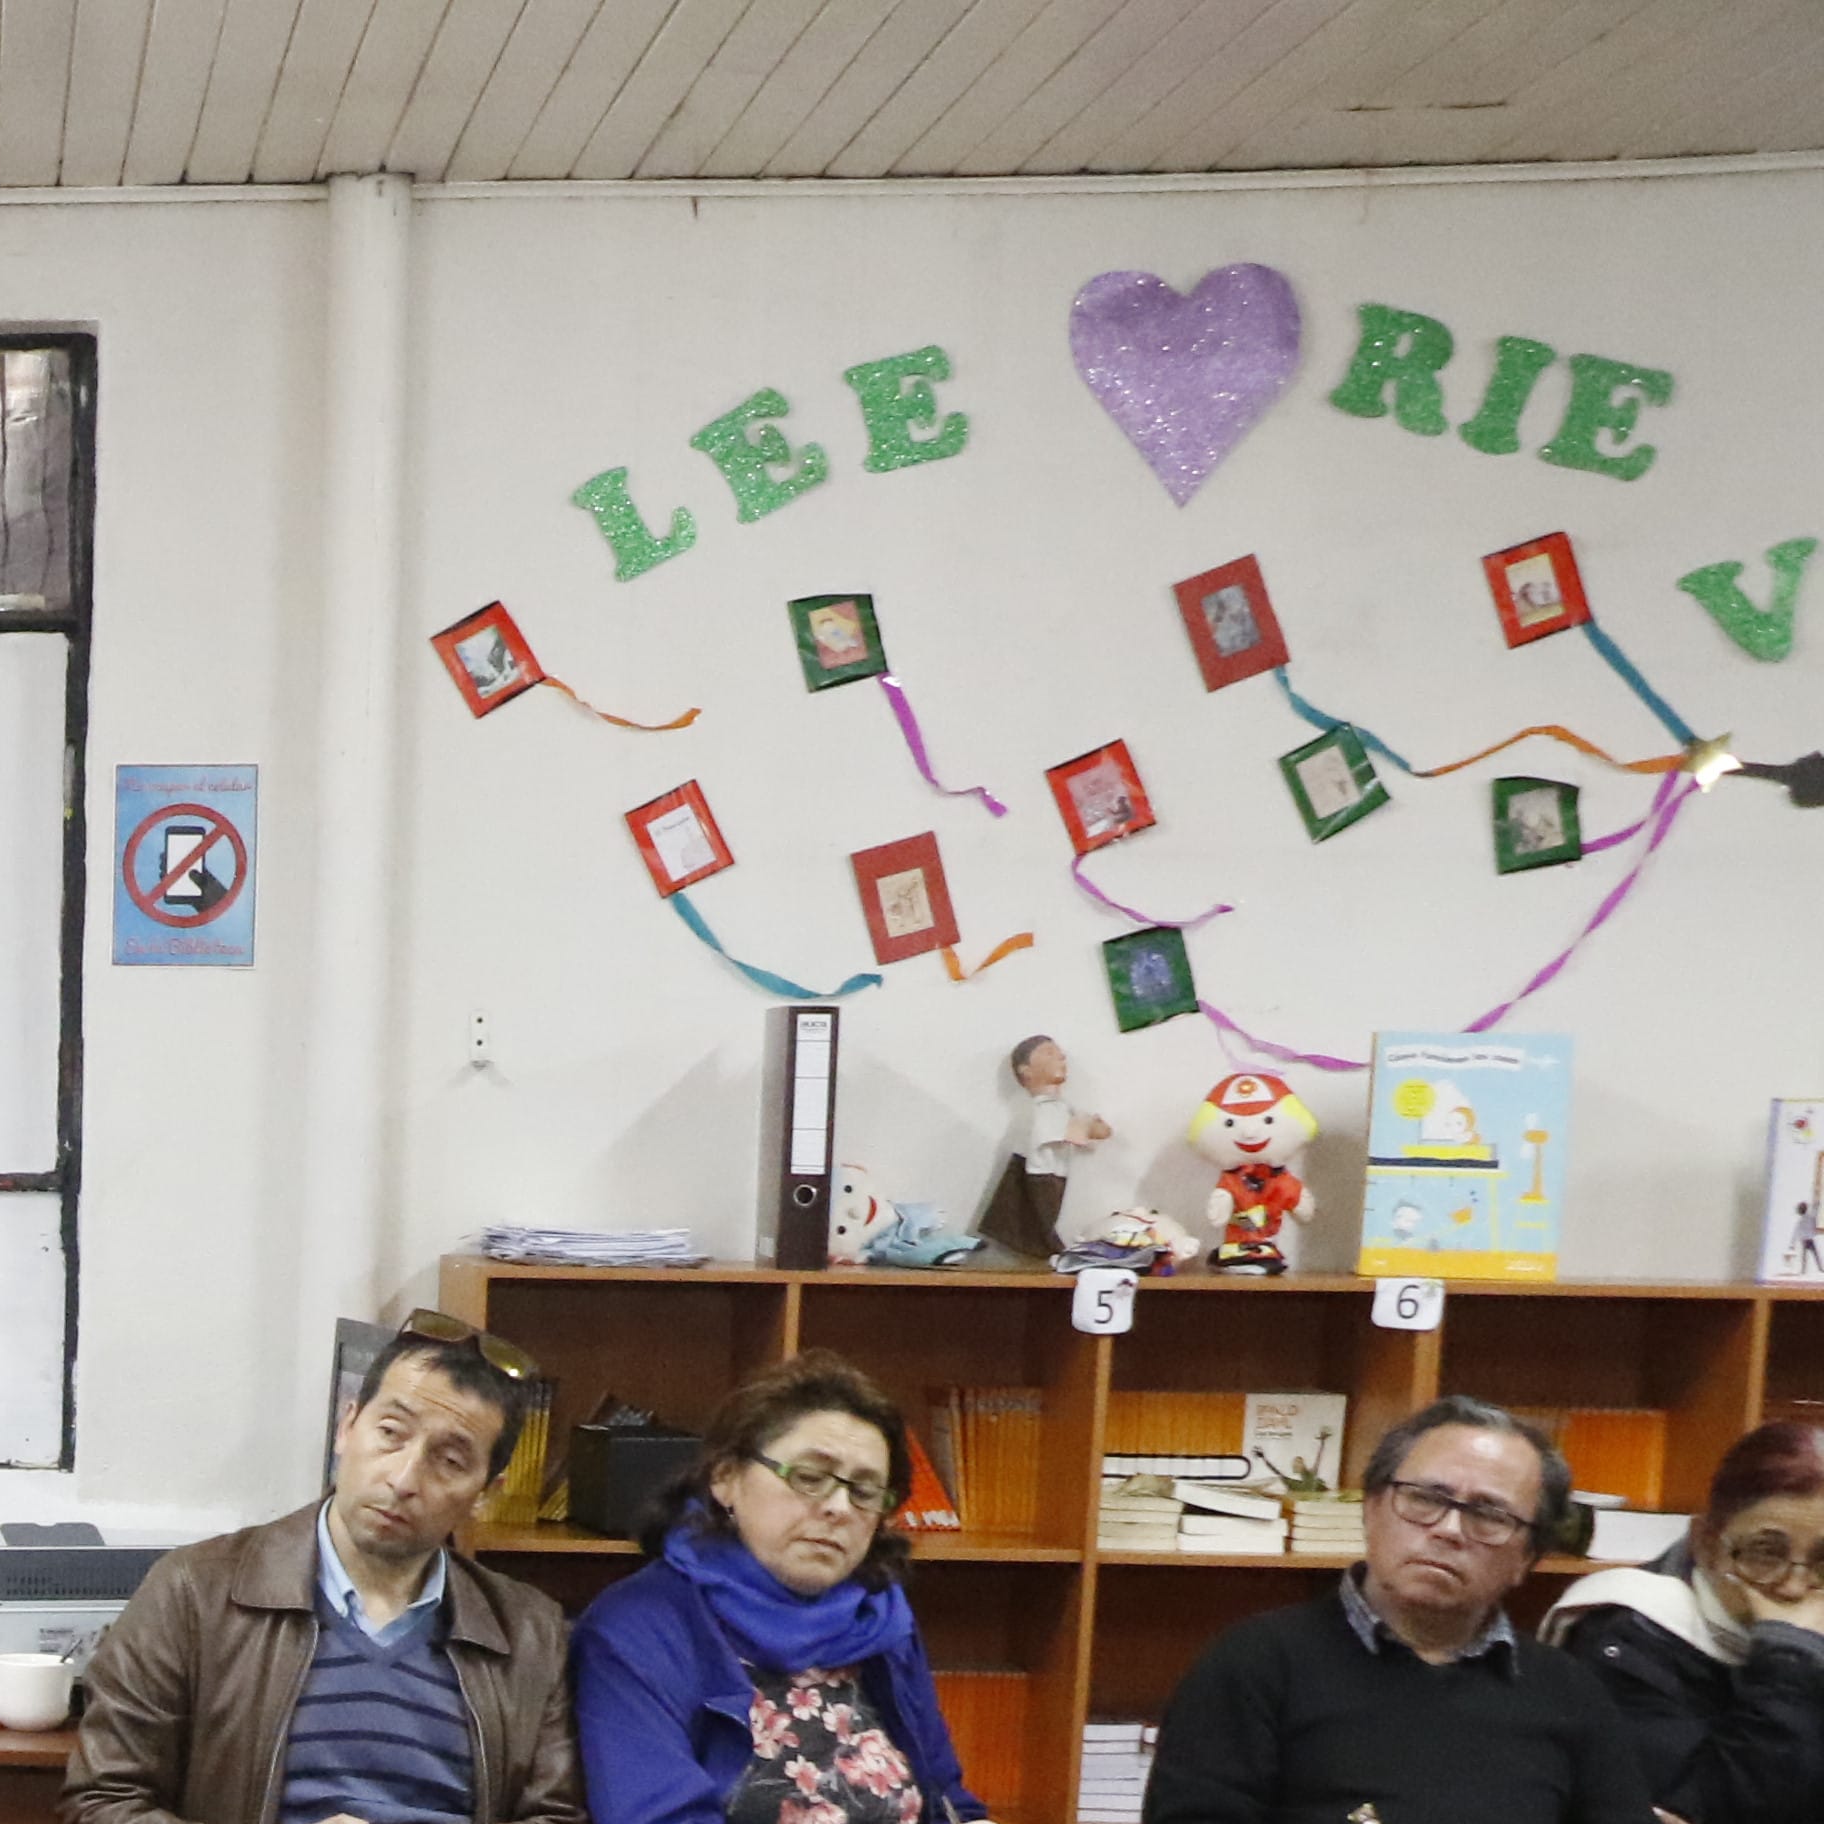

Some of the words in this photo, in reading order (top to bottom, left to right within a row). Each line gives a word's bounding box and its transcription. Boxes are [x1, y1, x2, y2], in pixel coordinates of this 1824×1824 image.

[573, 345, 969, 580] LEE
[1329, 303, 1673, 481] RIE
[1094, 1290, 1114, 1324] 5
[1396, 1284, 1419, 1320] 6
